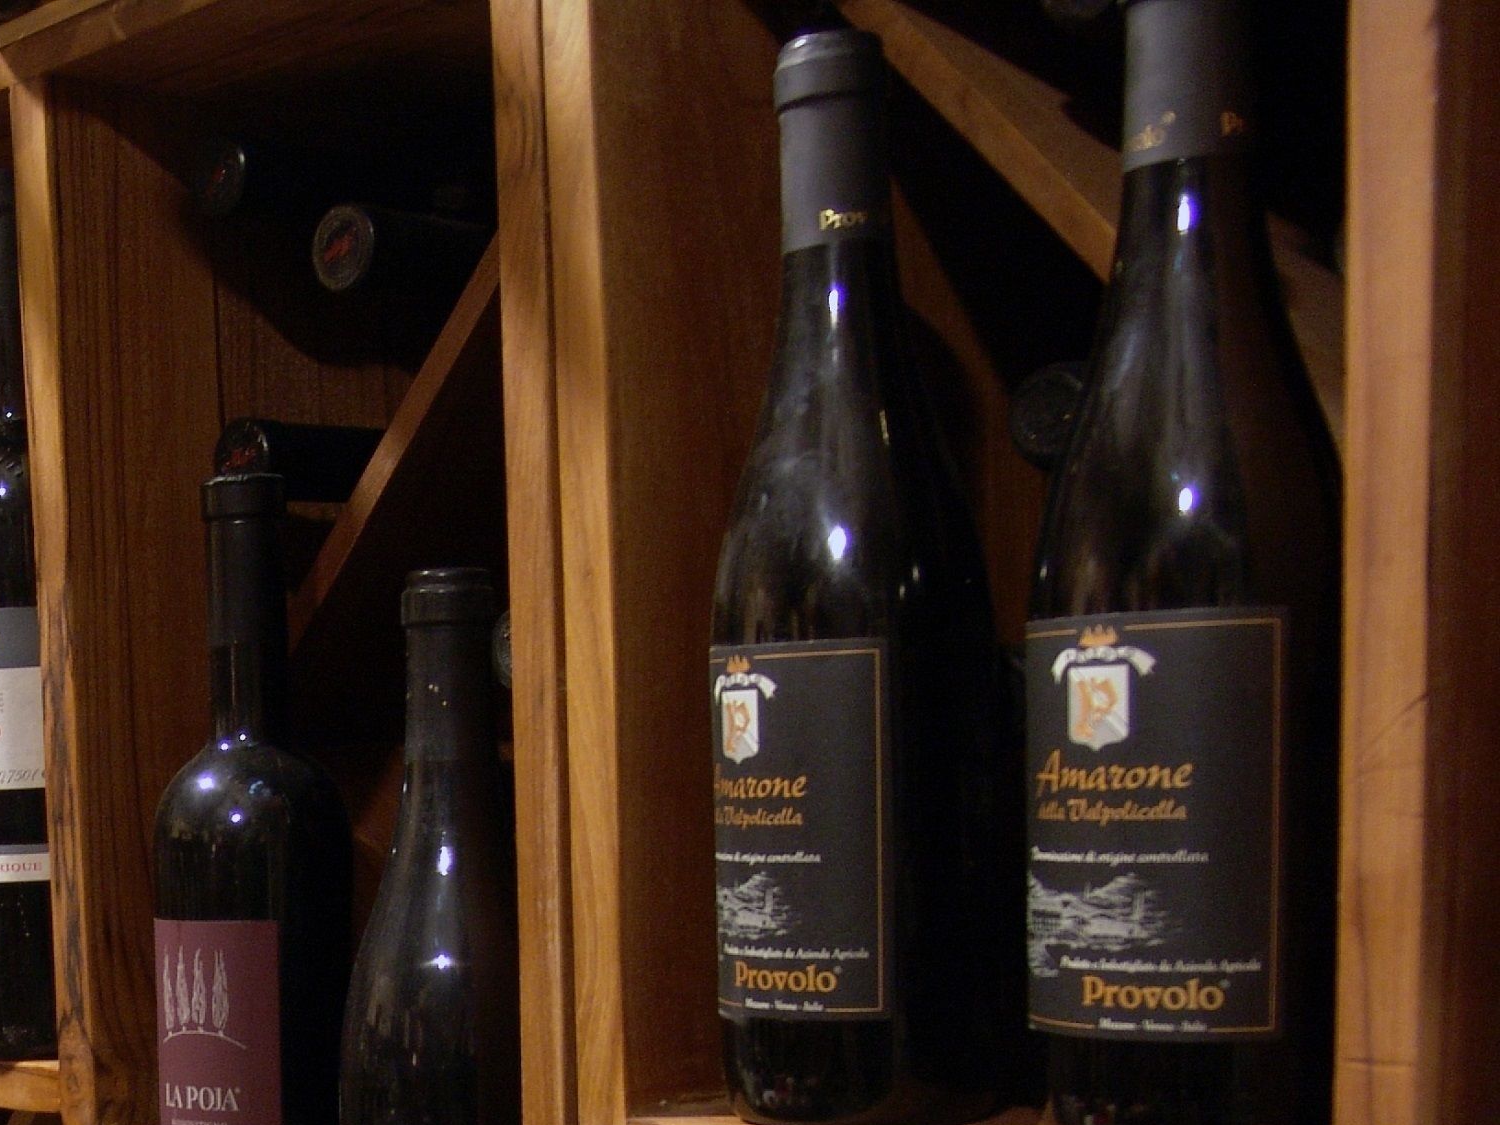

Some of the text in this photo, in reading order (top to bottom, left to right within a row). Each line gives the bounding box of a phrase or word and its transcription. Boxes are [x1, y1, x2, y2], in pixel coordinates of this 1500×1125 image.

[1035, 749, 1193, 800] Amarone
[734, 960, 838, 993] Provolo
[1081, 973, 1226, 1012] Provolo
[166, 1082, 183, 1109] LA
